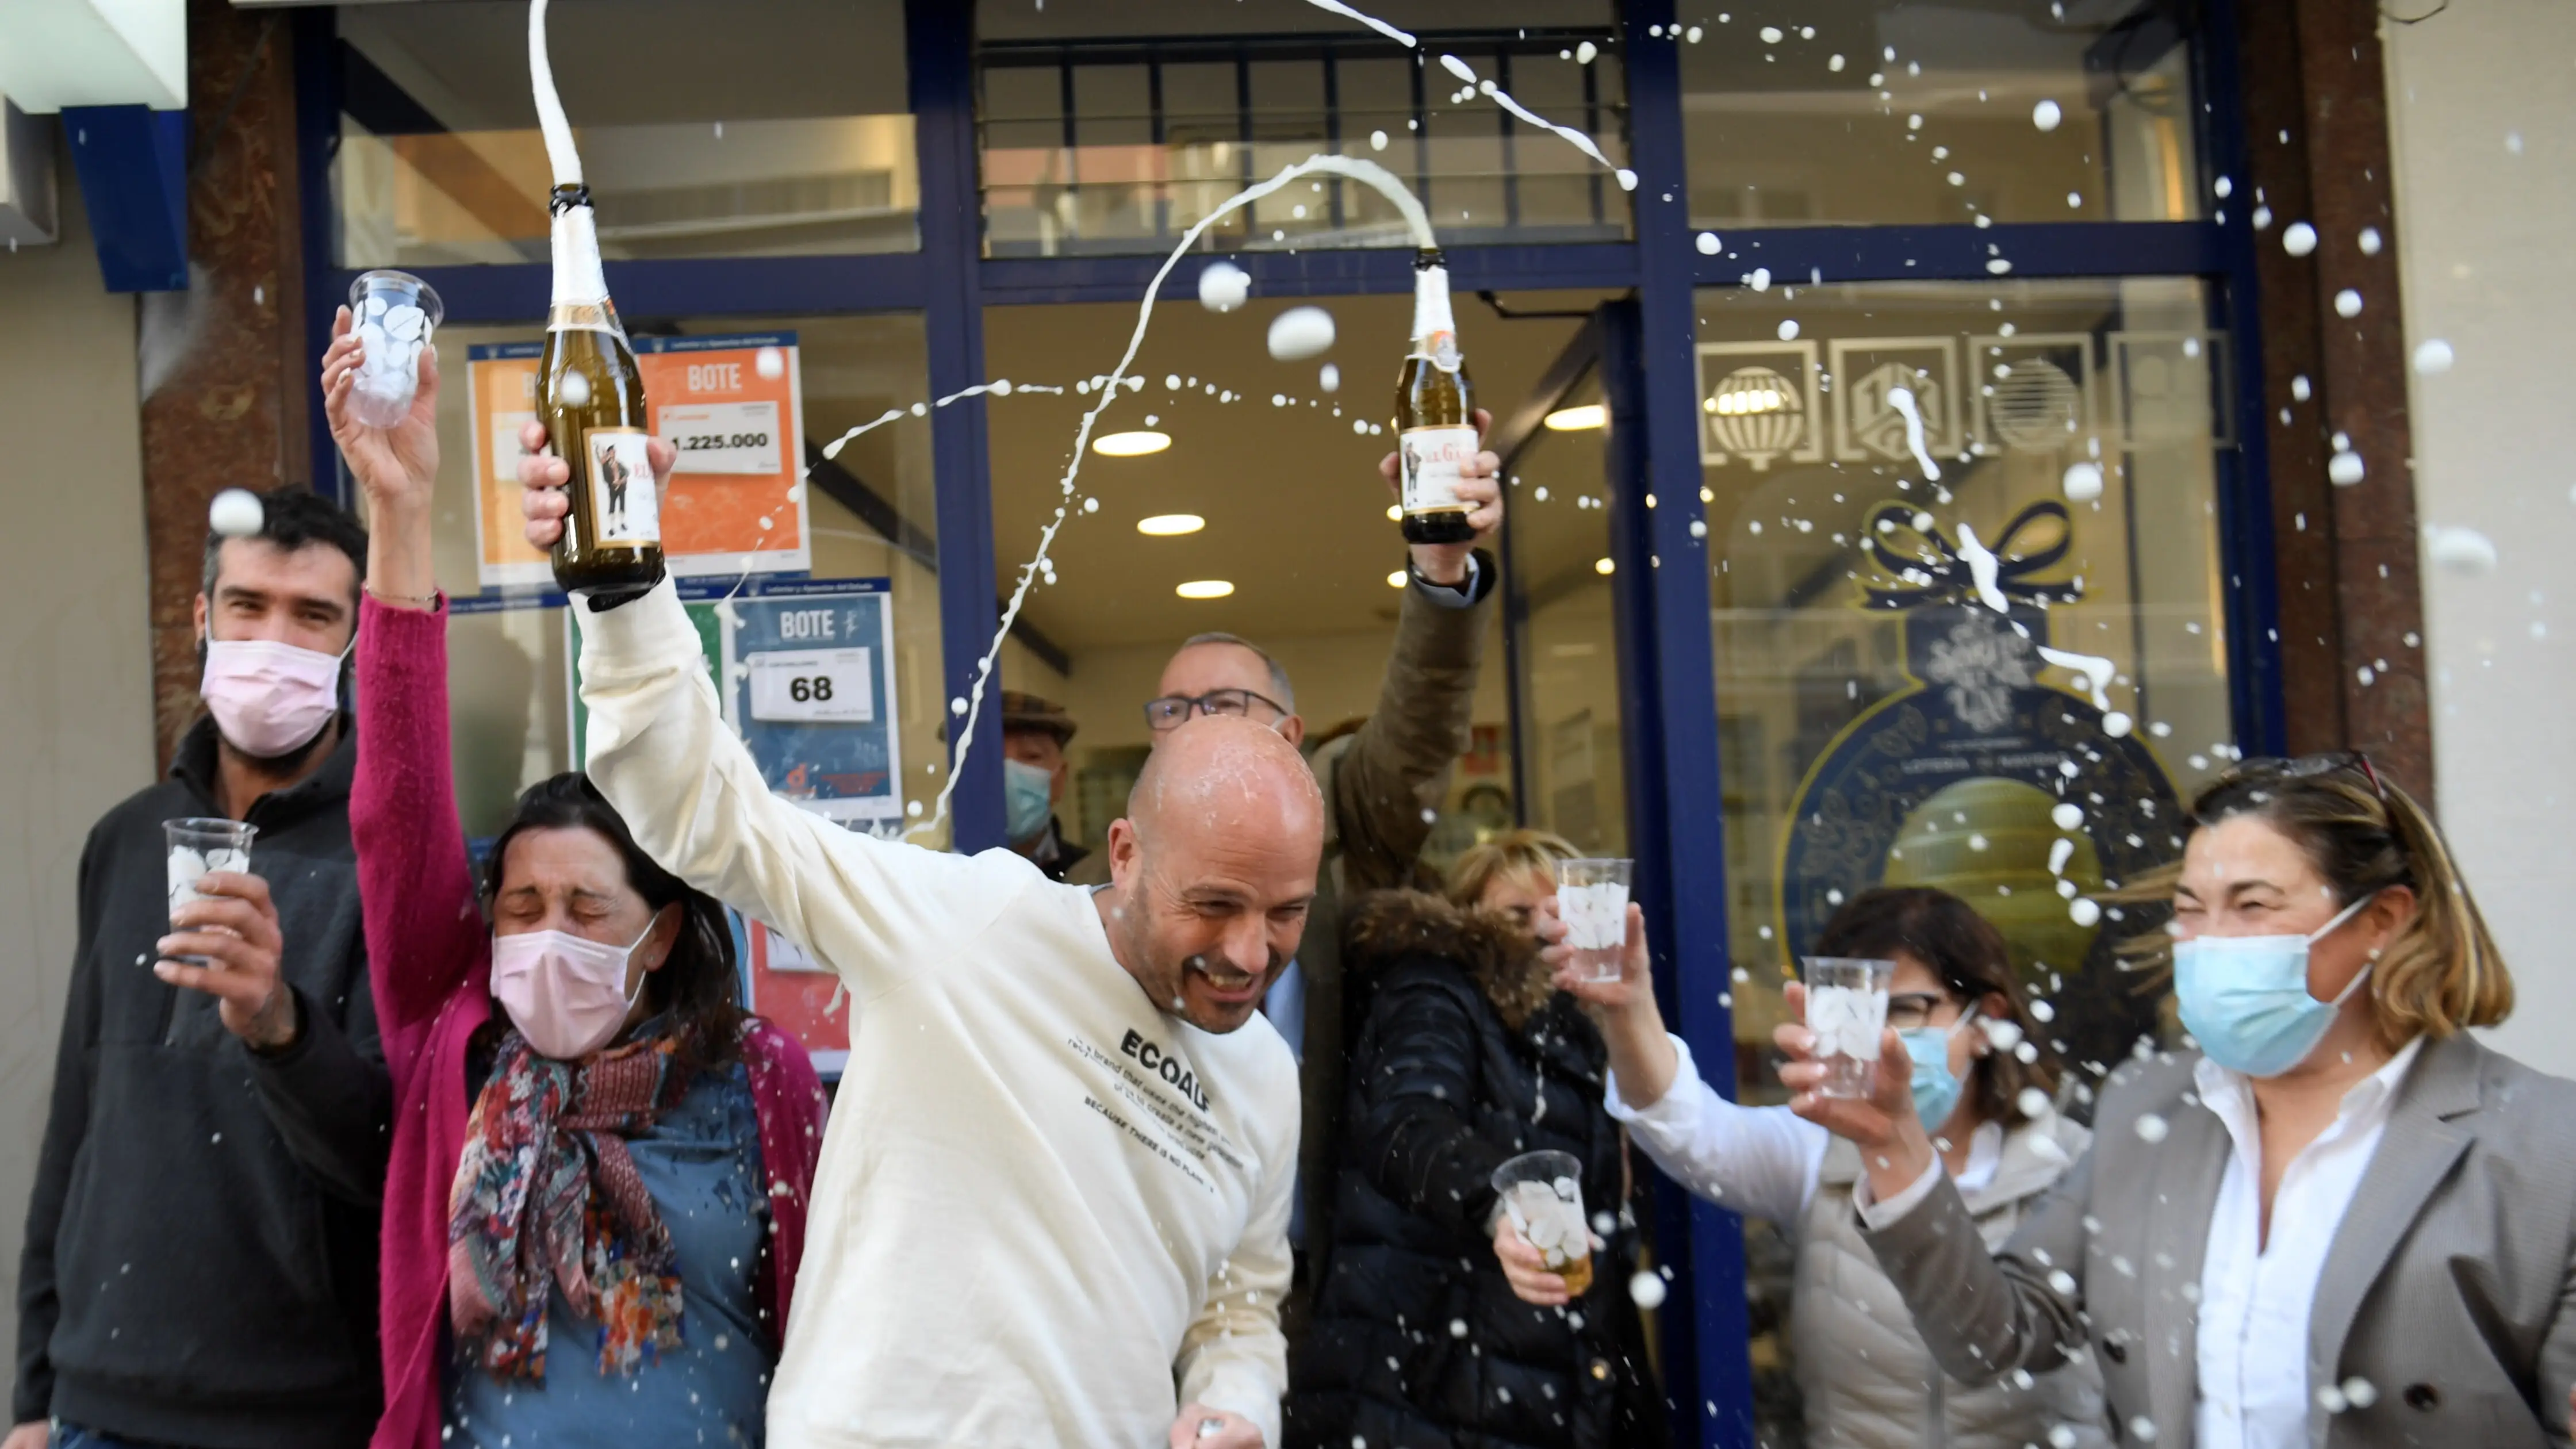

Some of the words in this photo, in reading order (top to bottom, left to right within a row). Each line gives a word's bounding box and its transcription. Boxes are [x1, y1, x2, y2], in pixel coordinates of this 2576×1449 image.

[688, 363, 743, 392] BOTE
[671, 432, 768, 452] 1.225.000
[780, 610, 836, 639] BOTE
[790, 676, 833, 703] 68
[1084, 1095, 1129, 1130] BECAUSE
[1129, 1126, 1159, 1152] THERE
